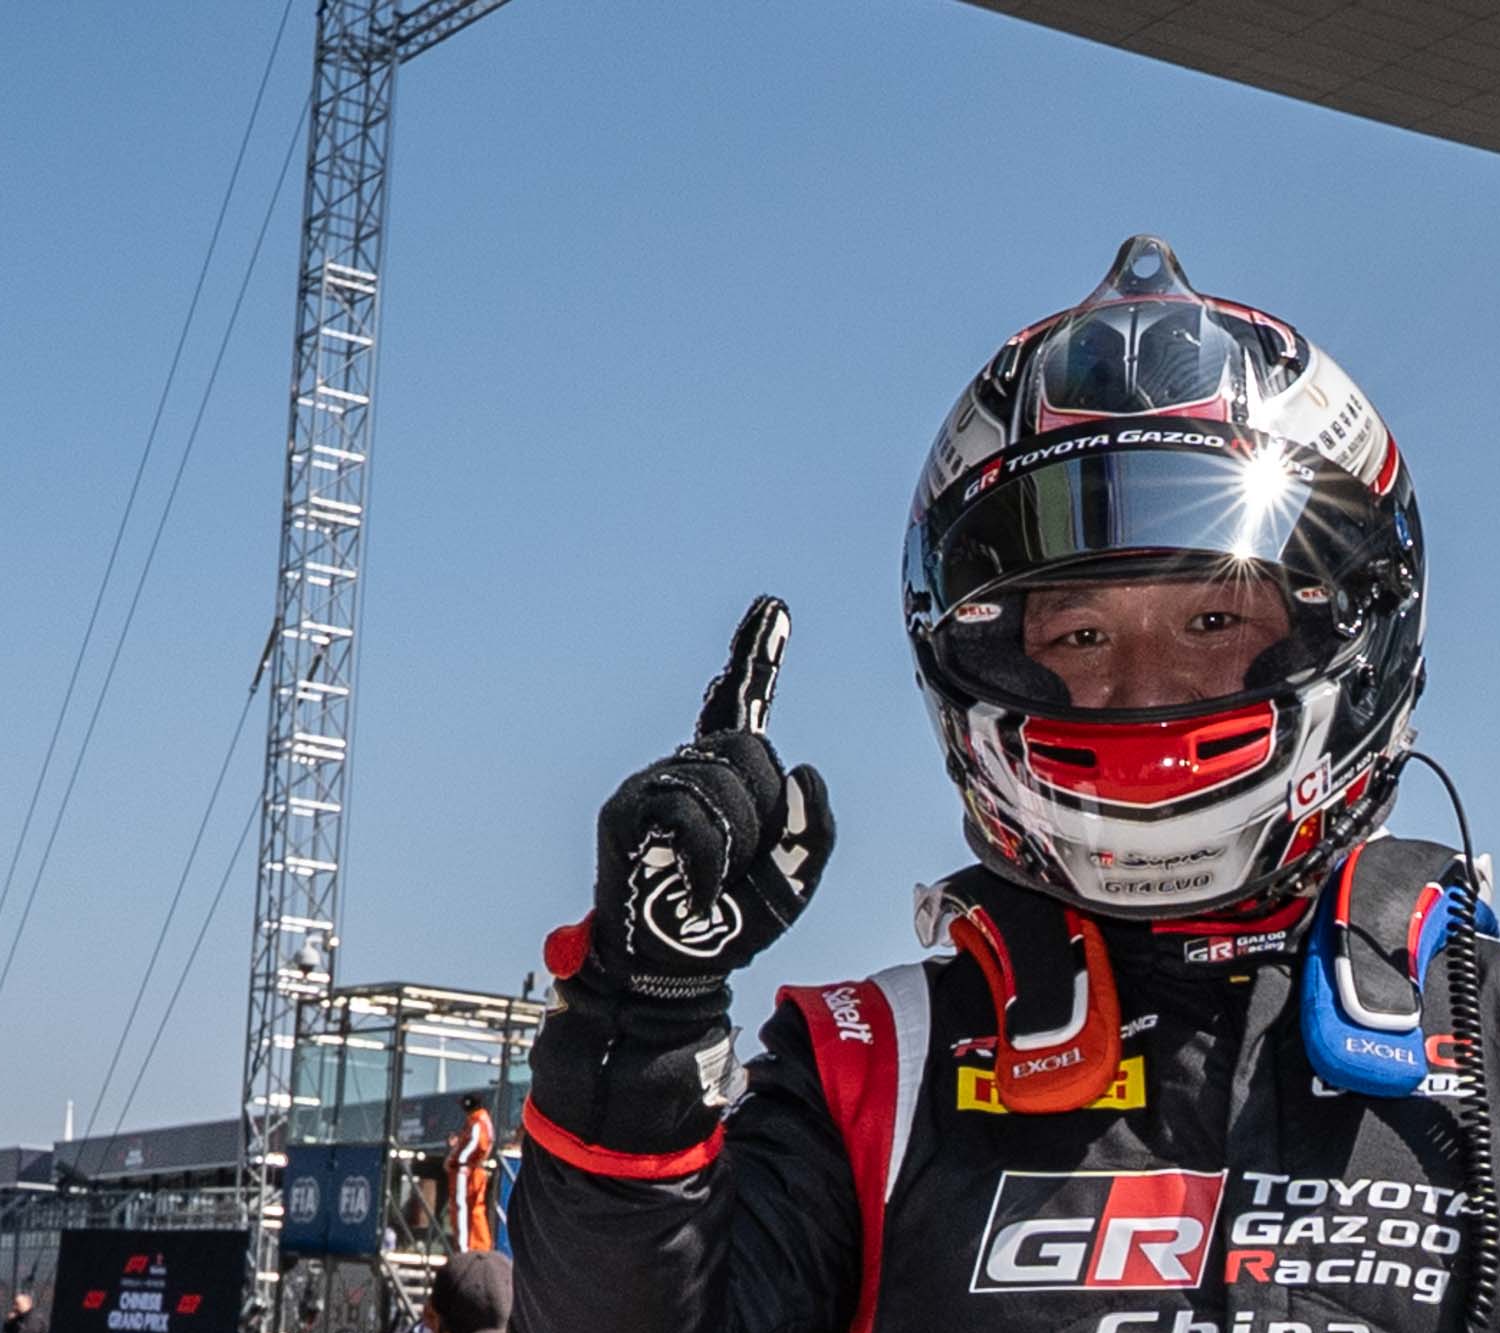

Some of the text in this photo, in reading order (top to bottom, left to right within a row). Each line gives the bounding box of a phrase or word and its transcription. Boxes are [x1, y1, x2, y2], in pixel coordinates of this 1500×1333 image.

[1006, 433, 1110, 472] TOYOTA
[1116, 429, 1224, 449] GAZOO
[1236, 931, 1287, 945] GAZOO
[1242, 1171, 1484, 1217] TOYOTA
[985, 1216, 1204, 1283] GR
[1231, 1211, 1461, 1255] GAZOO
[1223, 1249, 1451, 1305] Racing
[107, 1310, 170, 1333] GRAND PRIX
